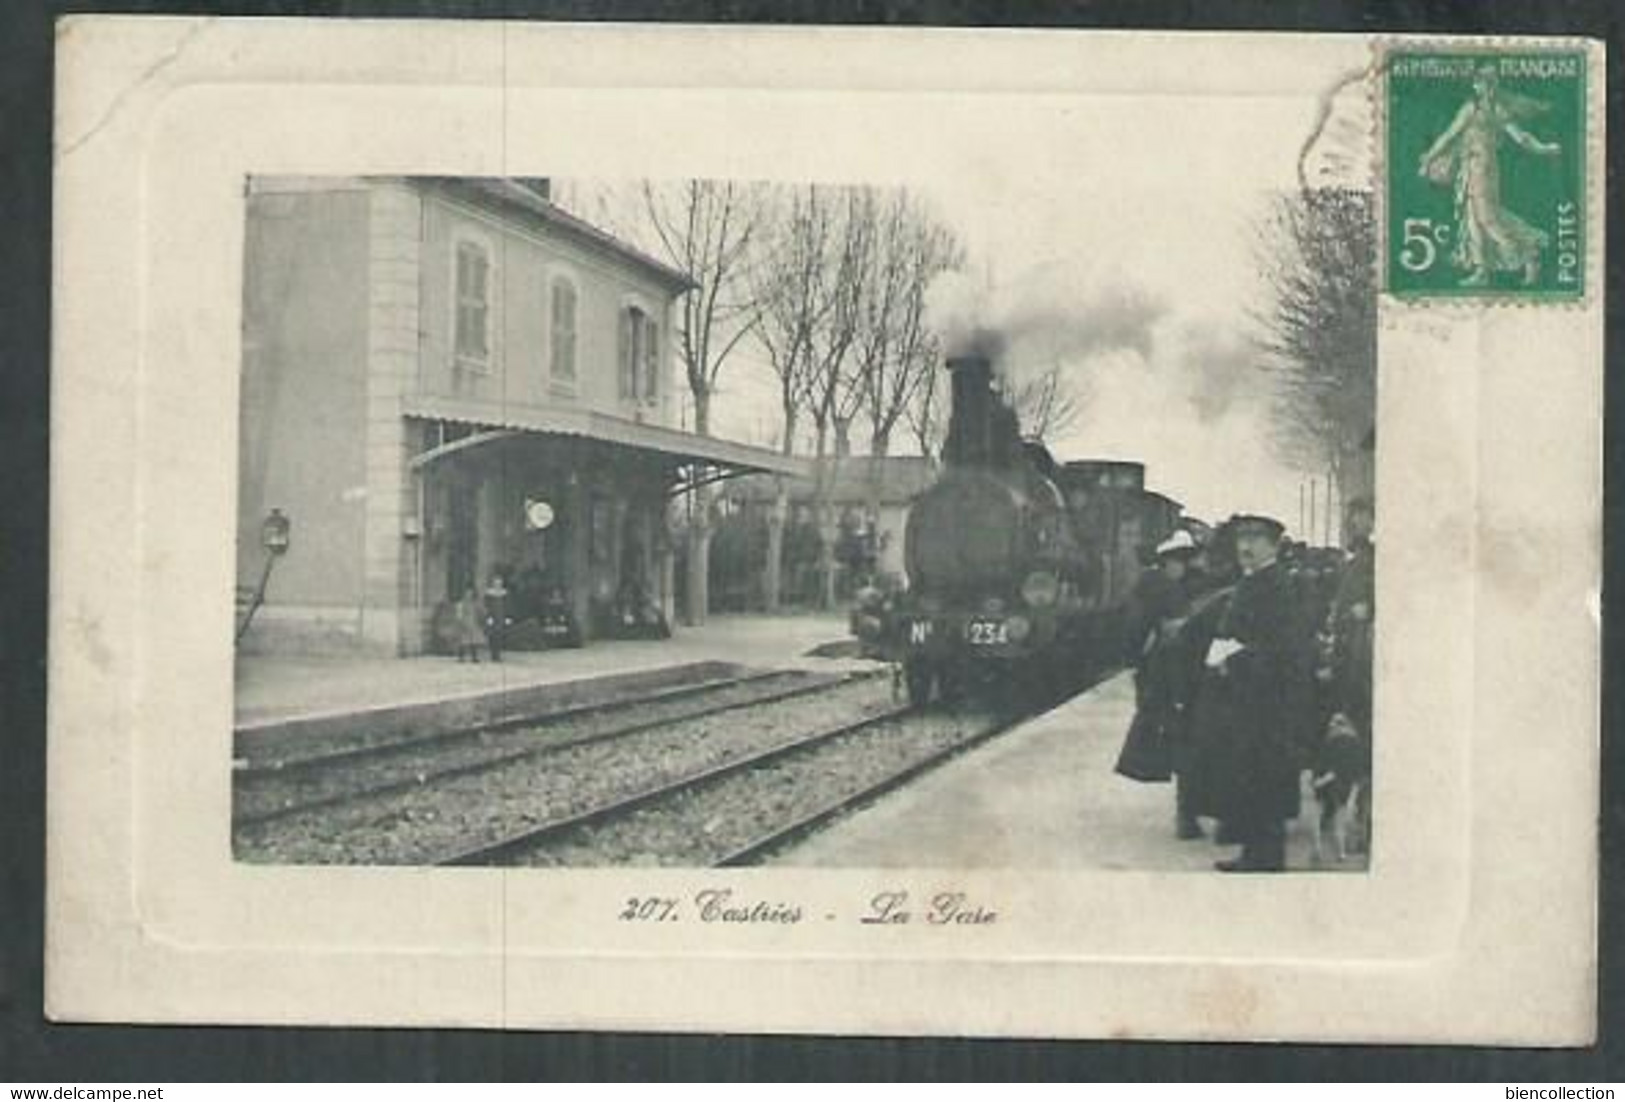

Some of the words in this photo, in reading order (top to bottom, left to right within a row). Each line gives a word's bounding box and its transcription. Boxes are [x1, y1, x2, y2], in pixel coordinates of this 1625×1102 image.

[1558, 202, 1577, 283] POSTES
[860, 891, 910, 925] La
[926, 892, 998, 925] Gare
